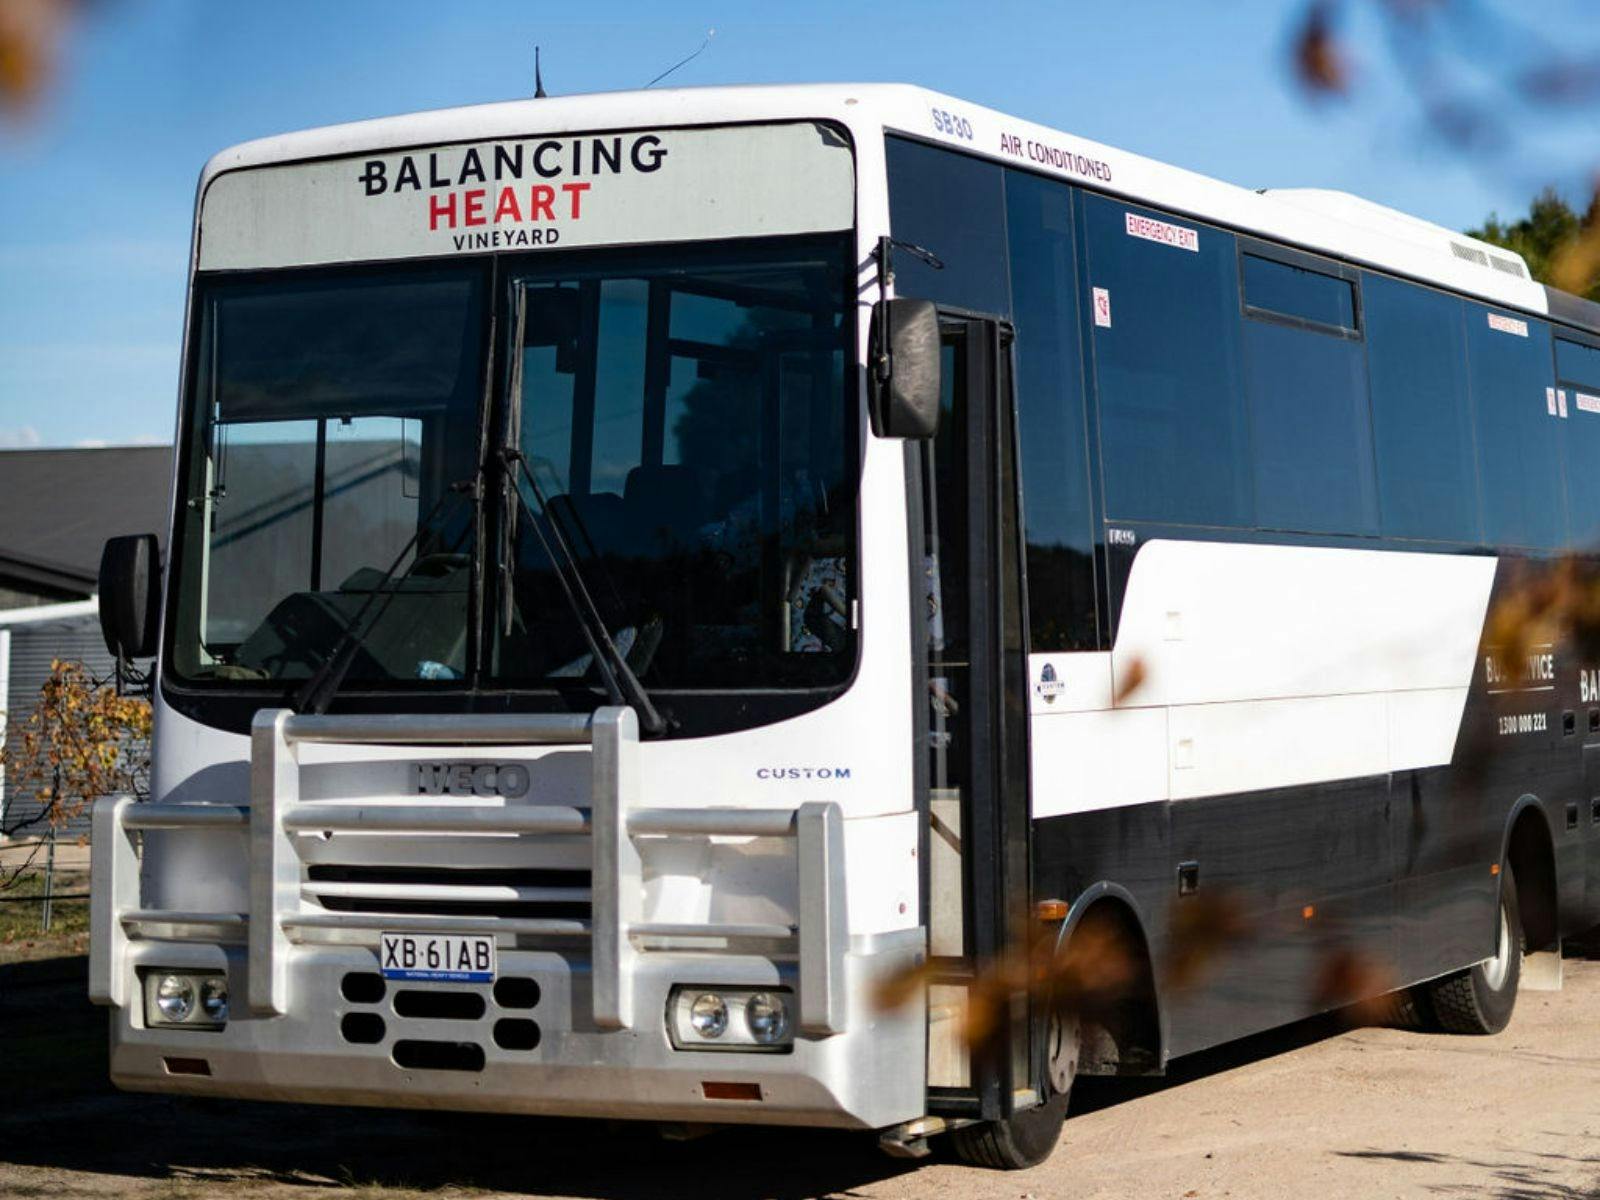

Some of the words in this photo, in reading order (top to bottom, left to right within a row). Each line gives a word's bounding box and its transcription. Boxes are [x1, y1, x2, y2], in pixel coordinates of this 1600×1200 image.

[931, 107, 974, 141] SB30
[358, 134, 668, 196] BALANCING
[1001, 132, 1024, 157] AIR
[1027, 140, 1112, 182] CONDITIONED
[428, 182, 591, 231] HEART
[453, 228, 560, 250] VINEYARD
[1128, 215, 1178, 244] EMERGENCY
[1179, 229, 1195, 248] EXIT
[410, 763, 531, 799] IVECO
[756, 767, 851, 780] CUSTOM
